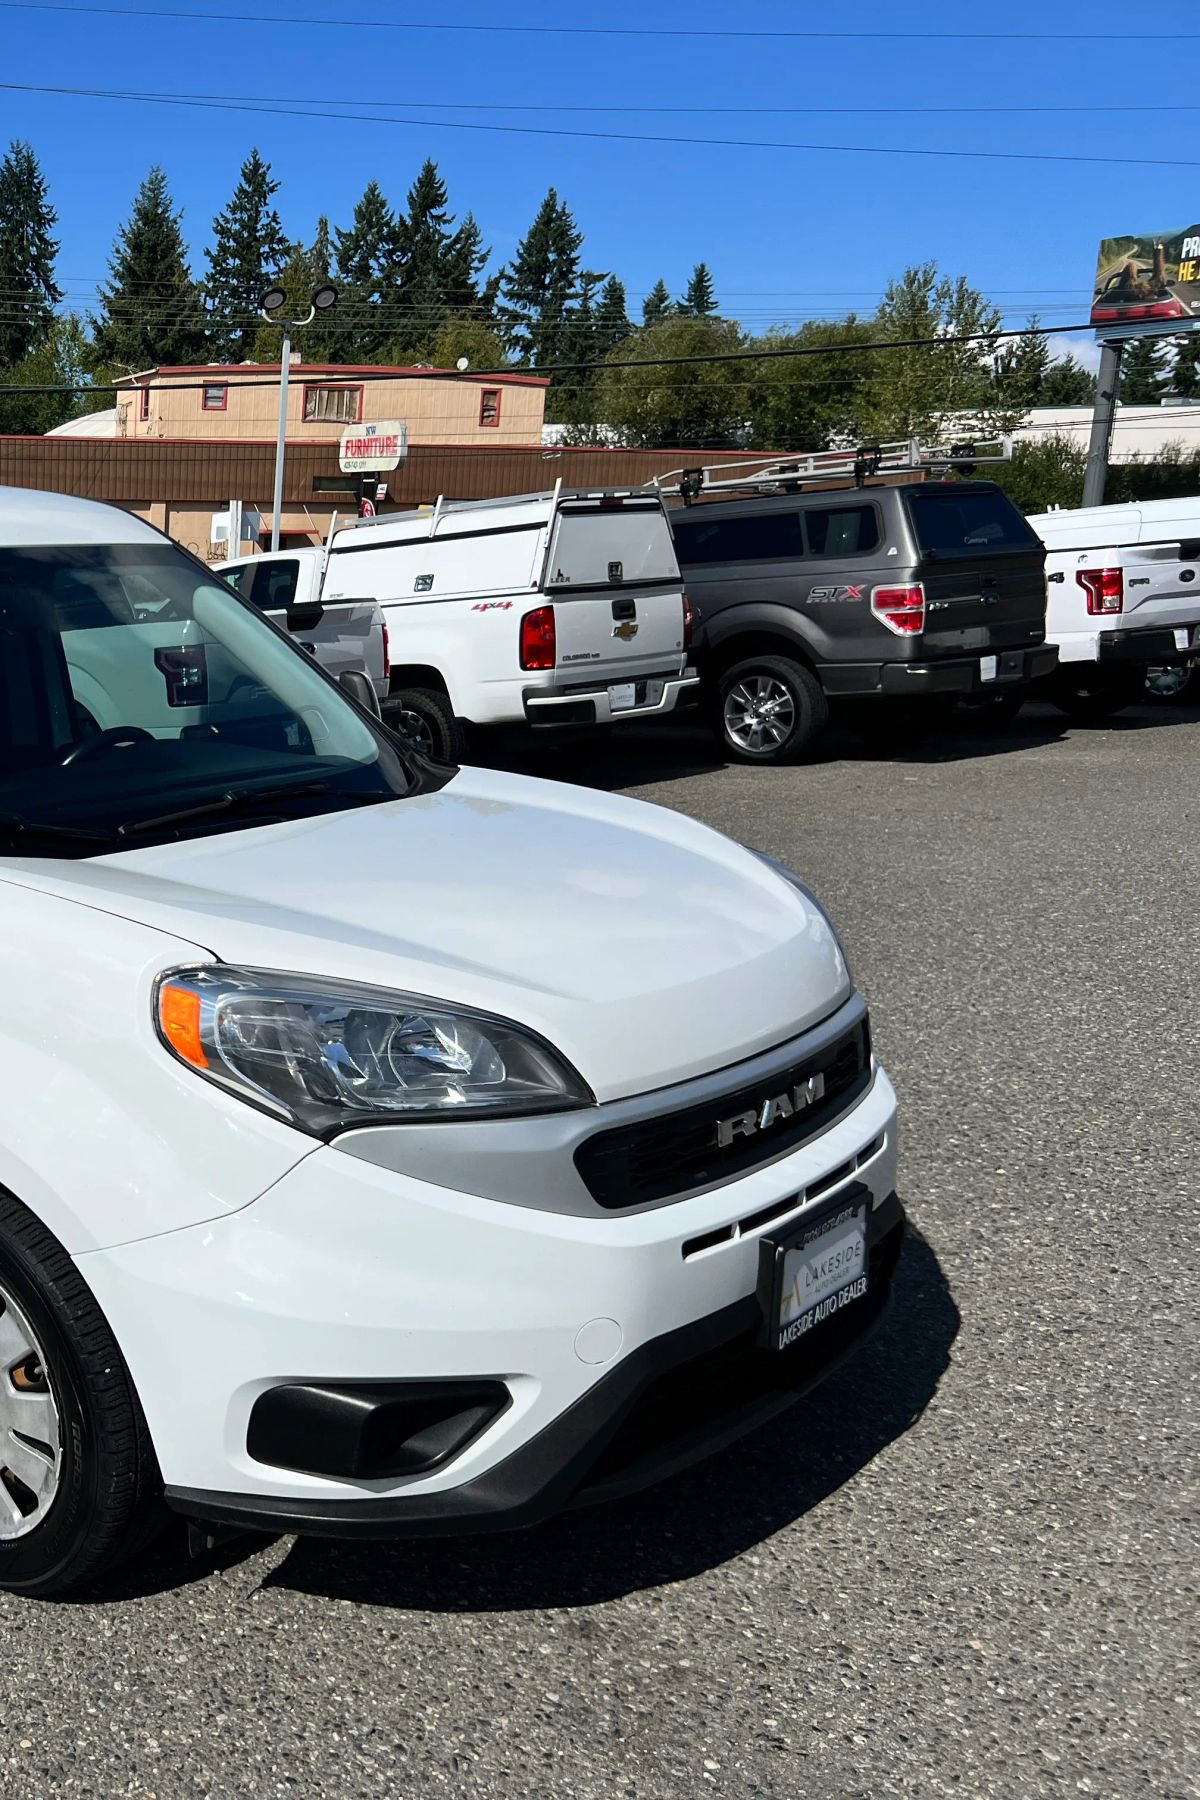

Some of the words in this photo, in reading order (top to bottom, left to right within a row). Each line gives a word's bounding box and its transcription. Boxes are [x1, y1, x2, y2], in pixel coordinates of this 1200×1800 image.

[1178, 260, 1196, 281] HE
[345, 435, 398, 457] FURNITURE
[808, 584, 868, 600] STX
[471, 601, 513, 612] 4x4
[717, 1072, 825, 1148] RAM
[805, 1240, 862, 1287] LAKESIDE
[779, 1311, 814, 1350] LAKESIDE
[814, 1295, 838, 1324] AUTO
[838, 1277, 868, 1309] DEALER
